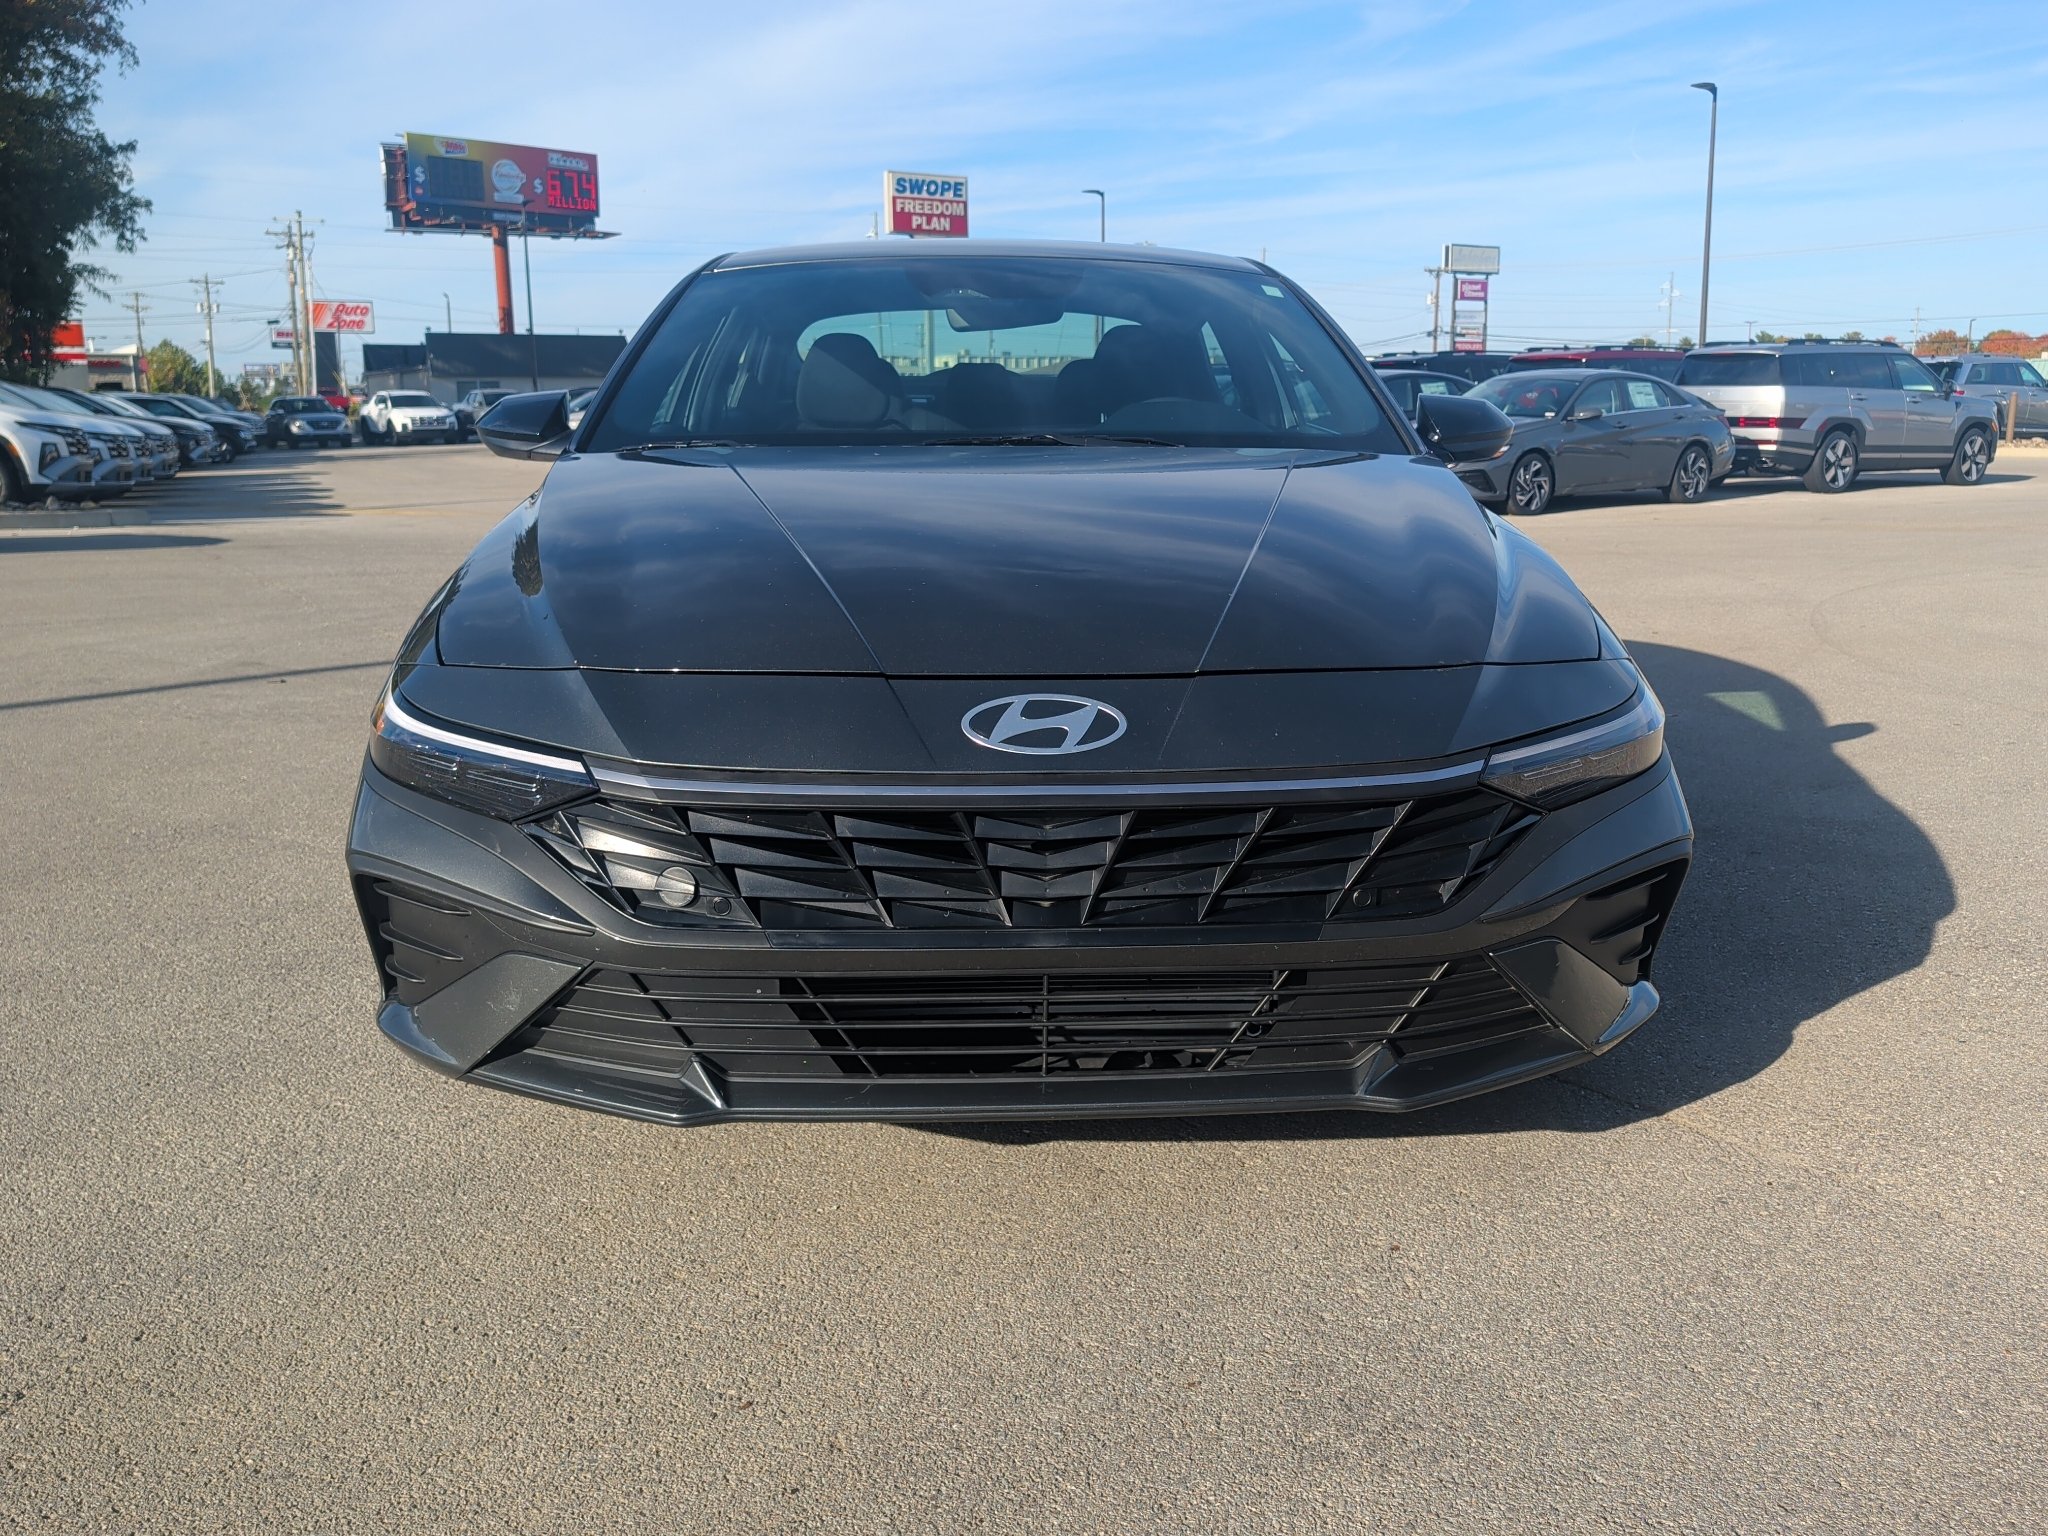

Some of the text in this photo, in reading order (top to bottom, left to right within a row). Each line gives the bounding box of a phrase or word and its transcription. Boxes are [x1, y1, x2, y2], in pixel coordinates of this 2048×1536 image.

[533, 177, 544, 194] $
[547, 168, 596, 200] 674
[895, 177, 965, 198] SWOPE
[547, 194, 597, 212] MILLION
[896, 198, 965, 216] FREEDOM
[911, 215, 951, 231] PLAN
[332, 303, 369, 317] Auto
[326, 314, 365, 330] Zone
